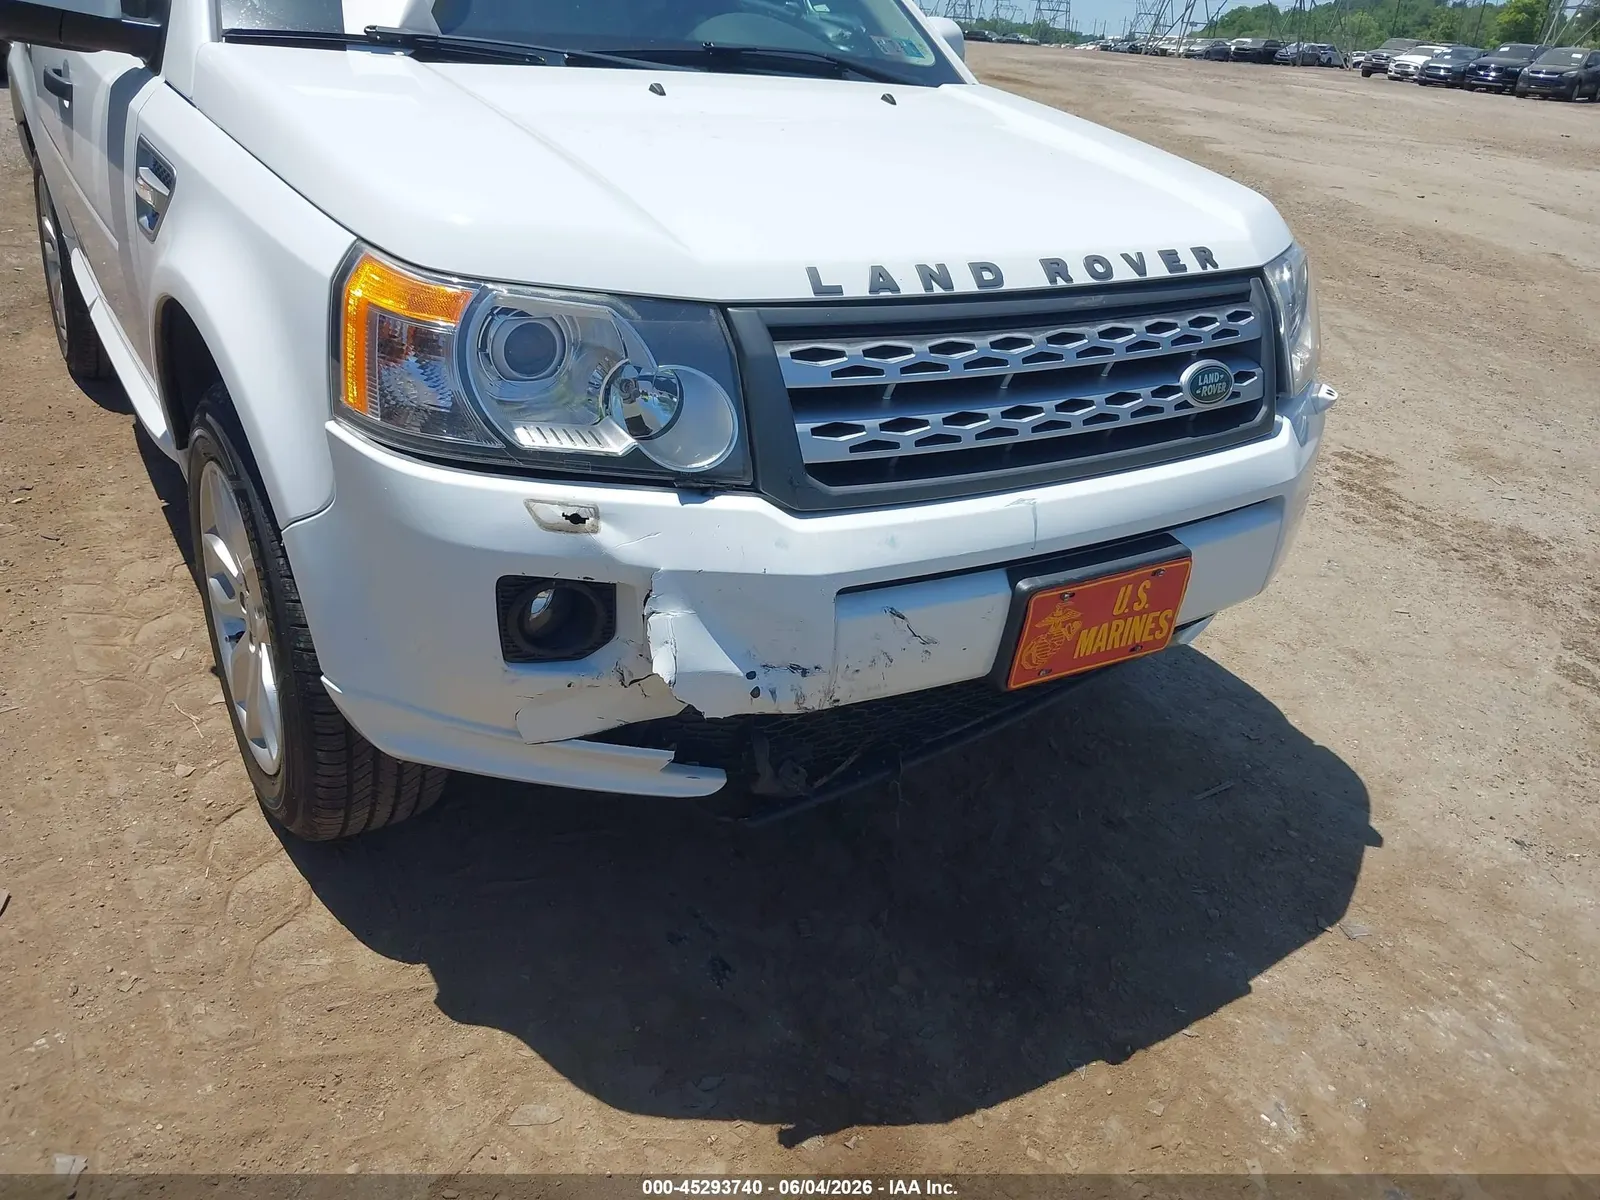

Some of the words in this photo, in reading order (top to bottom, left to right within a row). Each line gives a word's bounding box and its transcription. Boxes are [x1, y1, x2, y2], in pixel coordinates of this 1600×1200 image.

[805, 261, 1004, 296] LAND
[1039, 246, 1220, 286] ROVER
[1198, 372, 1220, 386] LAND
[1201, 382, 1227, 397] ROVER
[1112, 580, 1151, 615] U.S.
[1073, 609, 1173, 659] MARINES
